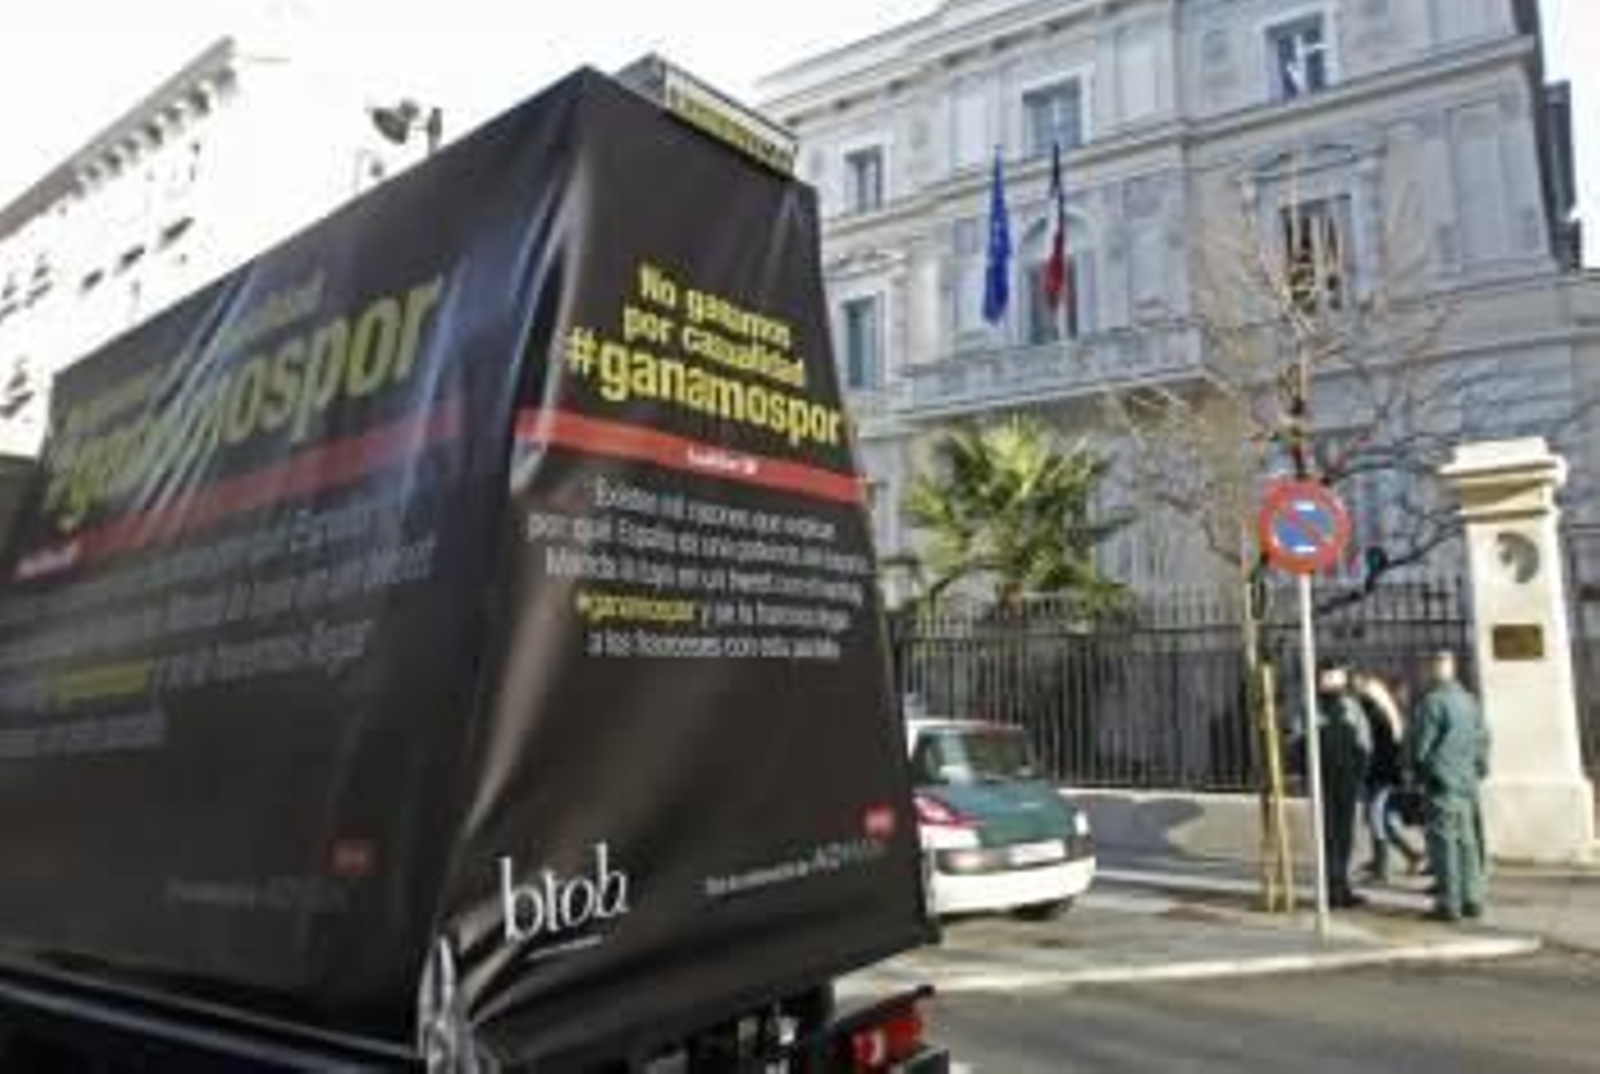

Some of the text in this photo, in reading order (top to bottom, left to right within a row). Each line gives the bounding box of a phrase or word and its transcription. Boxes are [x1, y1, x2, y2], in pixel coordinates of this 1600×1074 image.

[640, 264, 676, 308] No
[567, 326, 844, 448] #ganamospor
[624, 303, 806, 387] por casualidad
